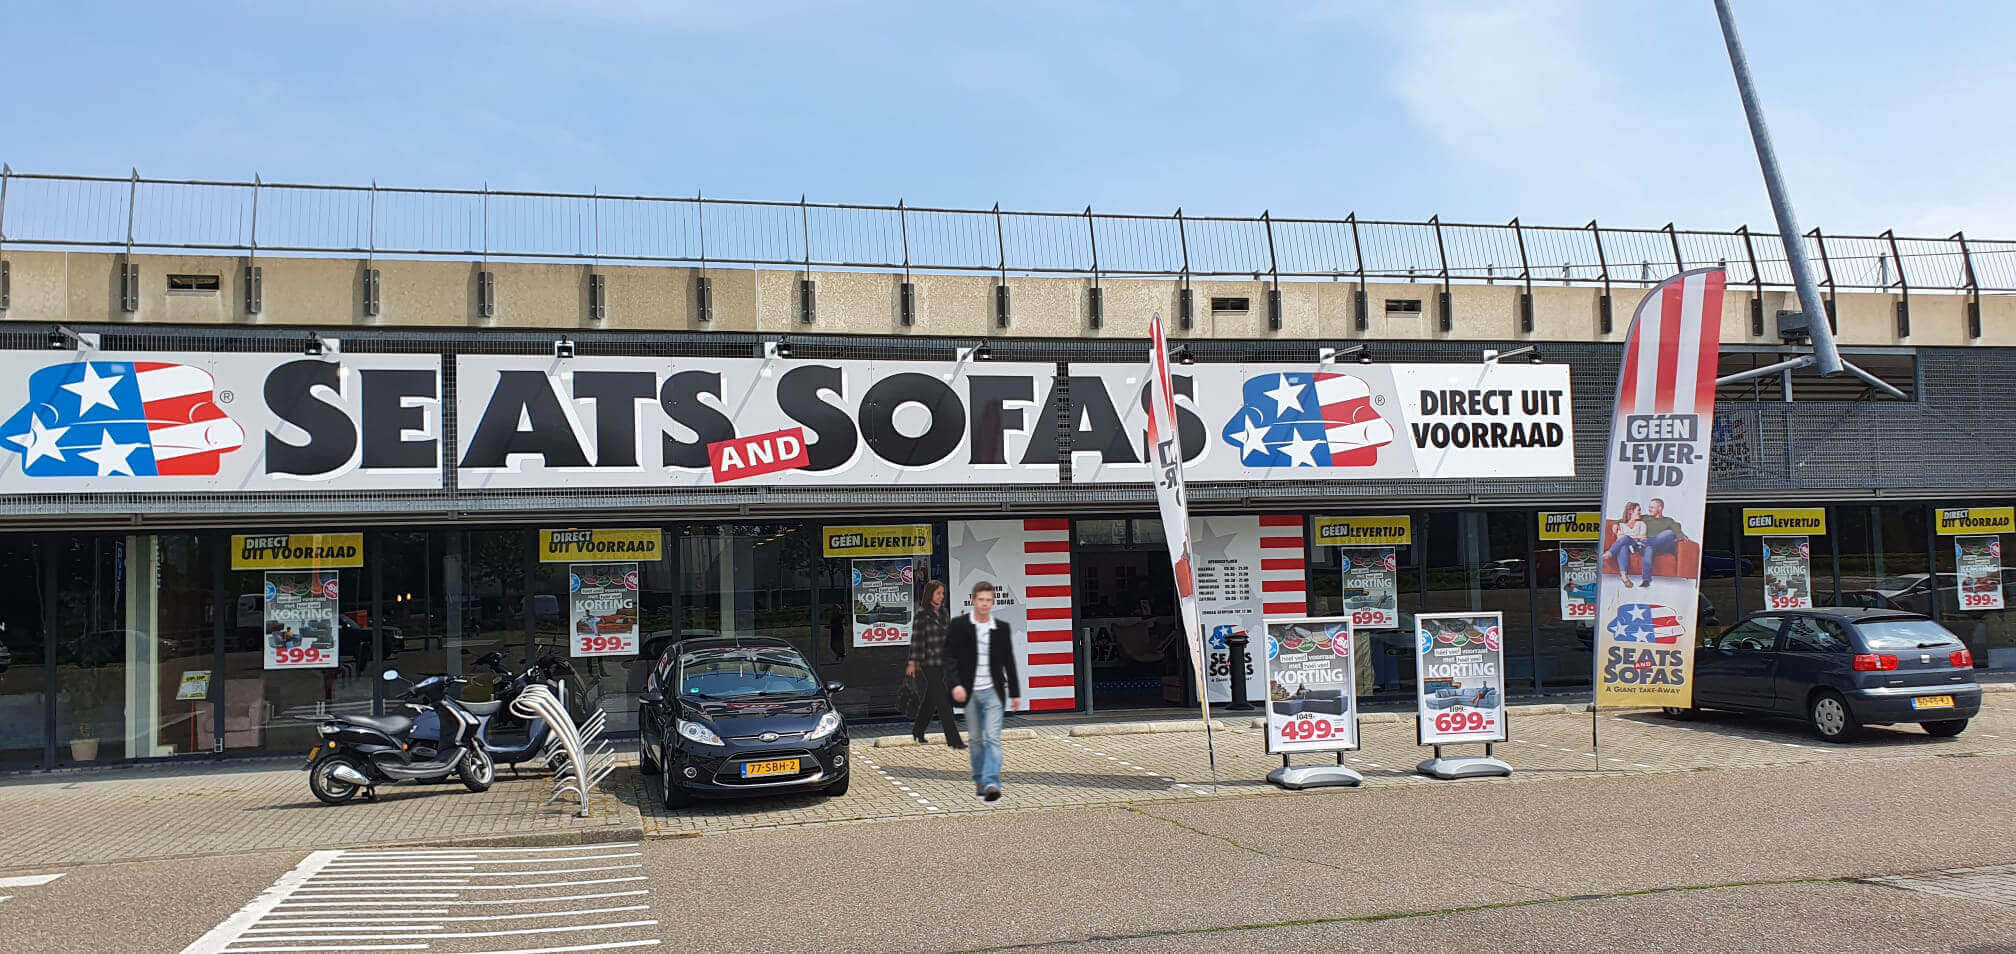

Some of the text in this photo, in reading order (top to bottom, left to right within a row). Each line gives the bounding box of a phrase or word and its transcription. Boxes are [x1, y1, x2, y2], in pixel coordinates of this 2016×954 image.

[1420, 389, 1563, 416] DIRECT UIT
[263, 359, 1206, 476] SEATS AND SOFAS
[1411, 422, 1564, 448] VOORRAAD
[1619, 440, 1704, 464] LEVER-
[1633, 464, 1684, 487] TIJD
[1547, 514, 1576, 524] DIRECT
[1944, 509, 1969, 519] DIRECT
[1545, 522, 1600, 533] UIT VOORR
[1774, 518, 1821, 528] LEVERTIJD
[1942, 517, 2010, 528] UIT VOORRAAD
[553, 530, 592, 543] DIRECT
[1351, 526, 1405, 538] LEVERTIJD
[246, 536, 289, 549] DIRECT
[549, 540, 656, 553] UIT VOORRAAD
[864, 535, 926, 548] LEVERTIJD
[241, 545, 357, 560] UIT VOORRAAD
[1564, 571, 1597, 582] KORTIN
[1768, 565, 1807, 576] KORTING
[1347, 578, 1392, 588] KORTING
[857, 591, 909, 603] KORTING
[575, 598, 633, 611] KORTING
[270, 607, 333, 620] KORTING
[862, 627, 909, 642] 499.-
[580, 636, 632, 652] 399.-
[275, 647, 331, 664] 599.-
[1210, 652, 1252, 665] SES
[1608, 646, 1683, 667] SEATS
[1209, 663, 1254, 677] SOS
[1274, 668, 1344, 684] KORTING
[1428, 662, 1495, 677] KORTING
[1604, 664, 1685, 685] SOFAS
[1435, 711, 1495, 732] 699.-
[1281, 719, 1344, 740] 499.-
